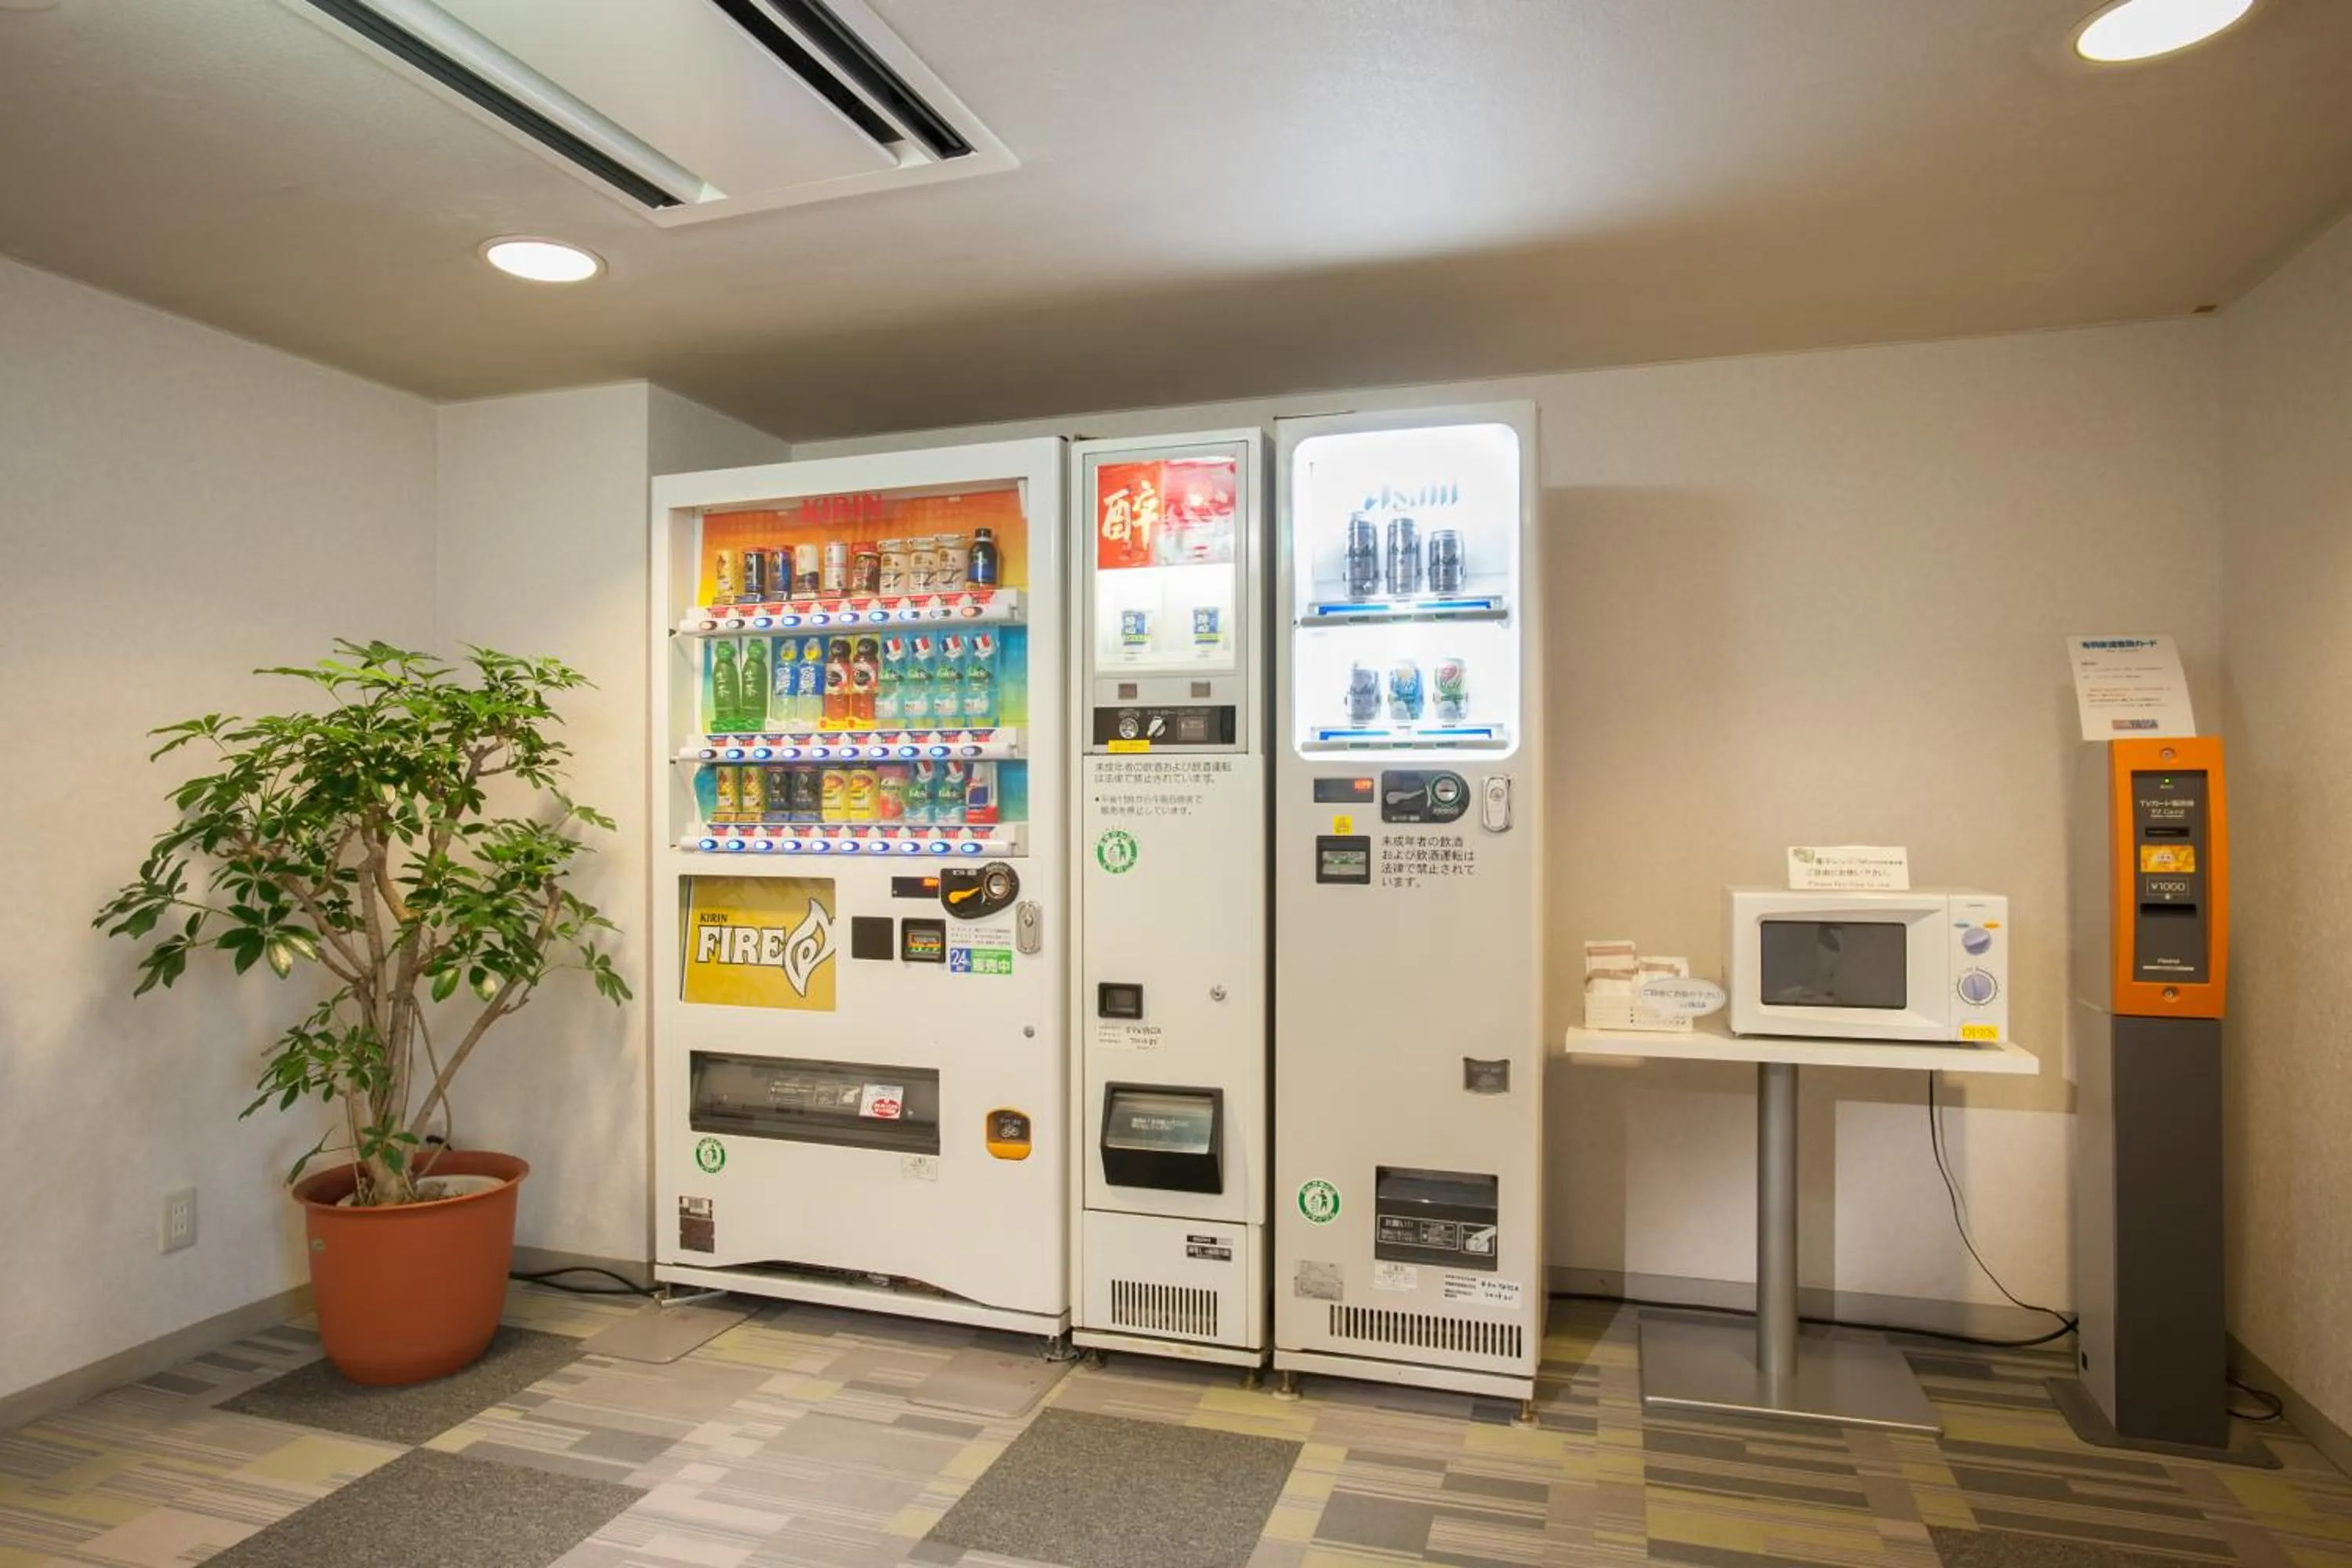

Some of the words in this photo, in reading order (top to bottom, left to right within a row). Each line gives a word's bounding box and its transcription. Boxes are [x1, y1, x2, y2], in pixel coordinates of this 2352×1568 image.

[801, 493, 883, 524] KIRIN
[744, 669, 759, 697] 生茶
[2150, 882, 2186, 891] ¥1000
[700, 913, 728, 923] KIRIN
[695, 924, 786, 967] FIRE
[952, 949, 971, 966] 24
